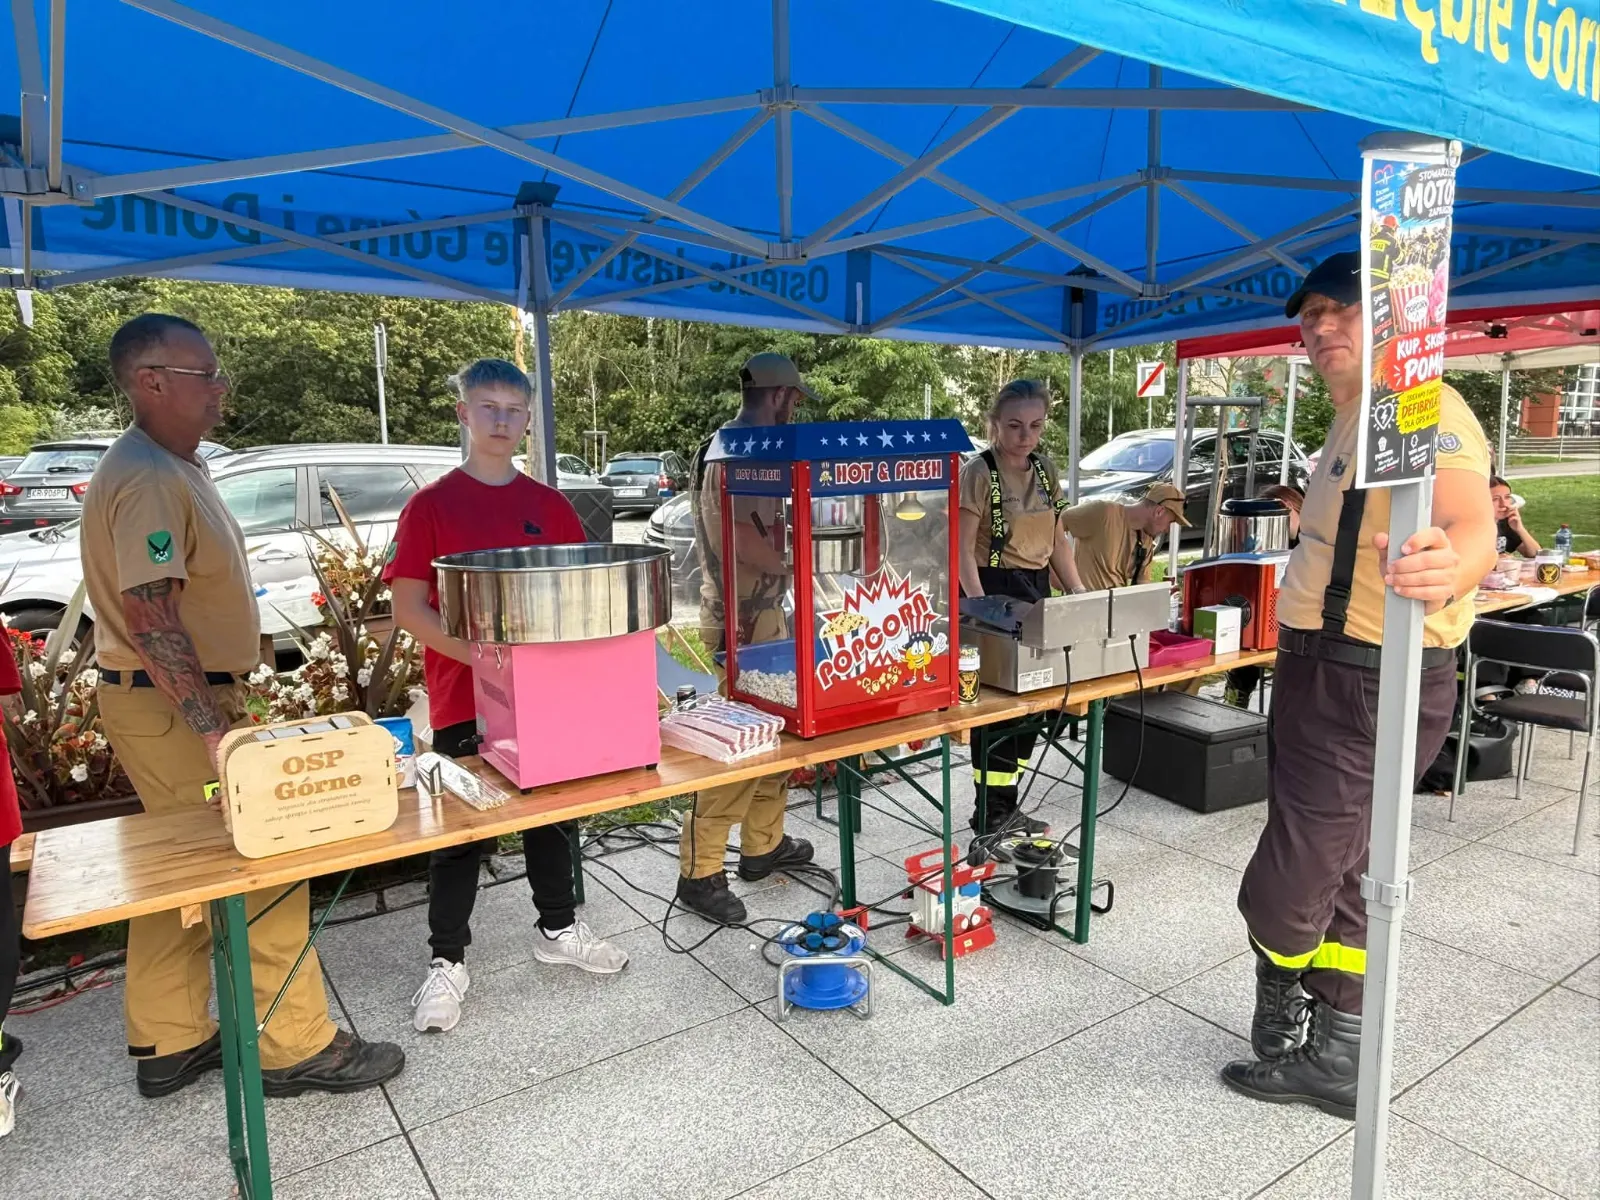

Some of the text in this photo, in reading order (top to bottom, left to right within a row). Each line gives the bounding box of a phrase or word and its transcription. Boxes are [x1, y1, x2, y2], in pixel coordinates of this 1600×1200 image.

[735, 468, 751, 480] HOT
[834, 459, 943, 485] HOT & FRESH
[817, 592, 929, 691] POPCORN
[282, 749, 344, 775] OSP
[274, 774, 362, 800] Górne
